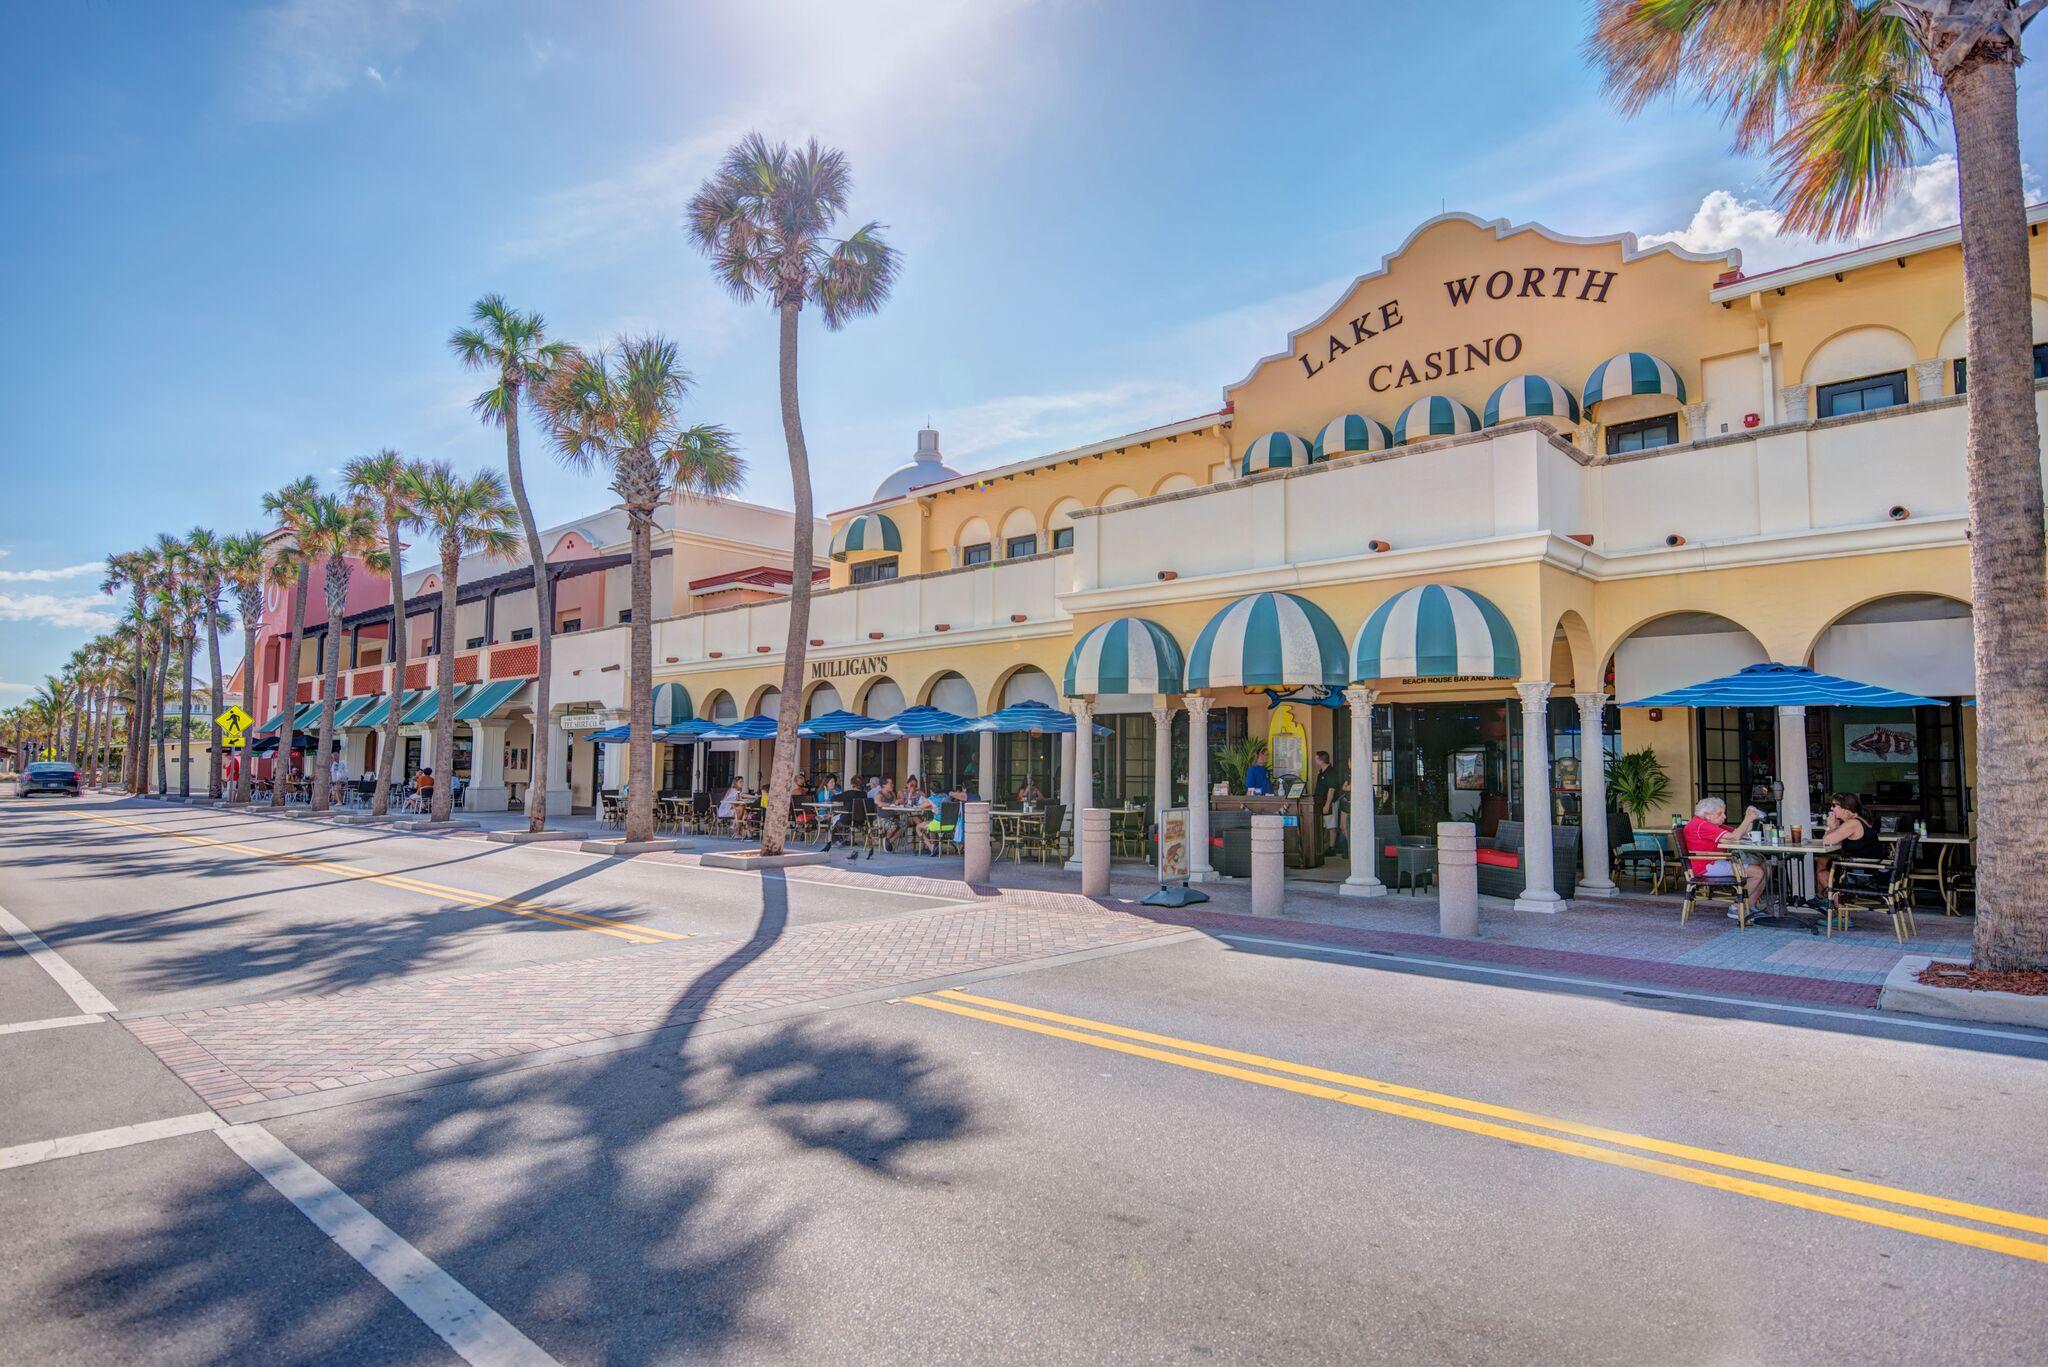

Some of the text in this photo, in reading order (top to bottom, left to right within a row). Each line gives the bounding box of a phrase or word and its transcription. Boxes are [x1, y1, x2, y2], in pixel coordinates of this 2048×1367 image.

[1299, 266, 1619, 380] LAKE WORTH
[1368, 332, 1523, 393] CASINO
[811, 655, 888, 679] MULLIGAN'S
[1402, 677, 1427, 685] BEACH
[1428, 676, 1453, 684] HOUSE
[1454, 675, 1470, 683] BAR
